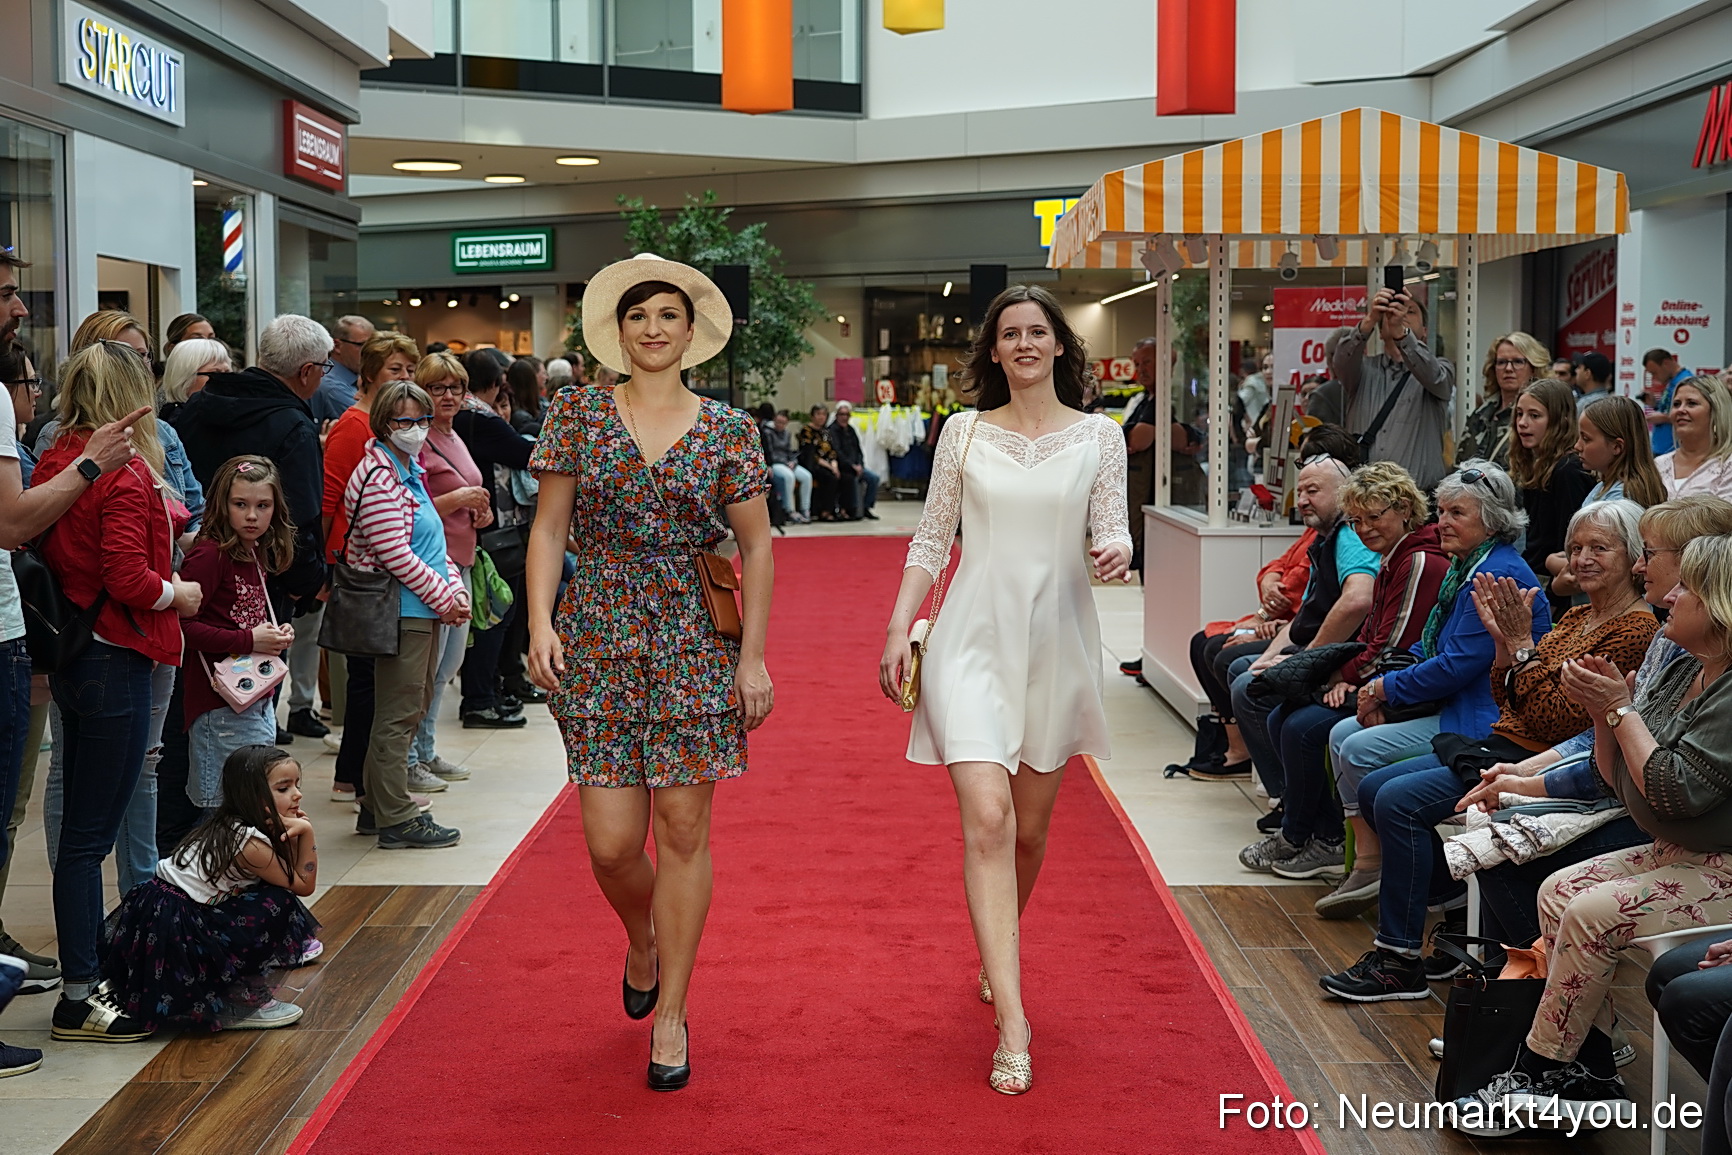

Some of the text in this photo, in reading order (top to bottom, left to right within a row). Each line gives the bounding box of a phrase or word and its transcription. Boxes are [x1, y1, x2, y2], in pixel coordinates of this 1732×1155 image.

[79, 17, 180, 112] STARCUT
[1692, 81, 1732, 168] M
[298, 129, 340, 167] LEBENSRAUM
[1033, 198, 1080, 248] T
[460, 241, 541, 259] LEBENSRAUM
[1655, 315, 1710, 328] Abholung
[1661, 300, 1703, 311] Online-
